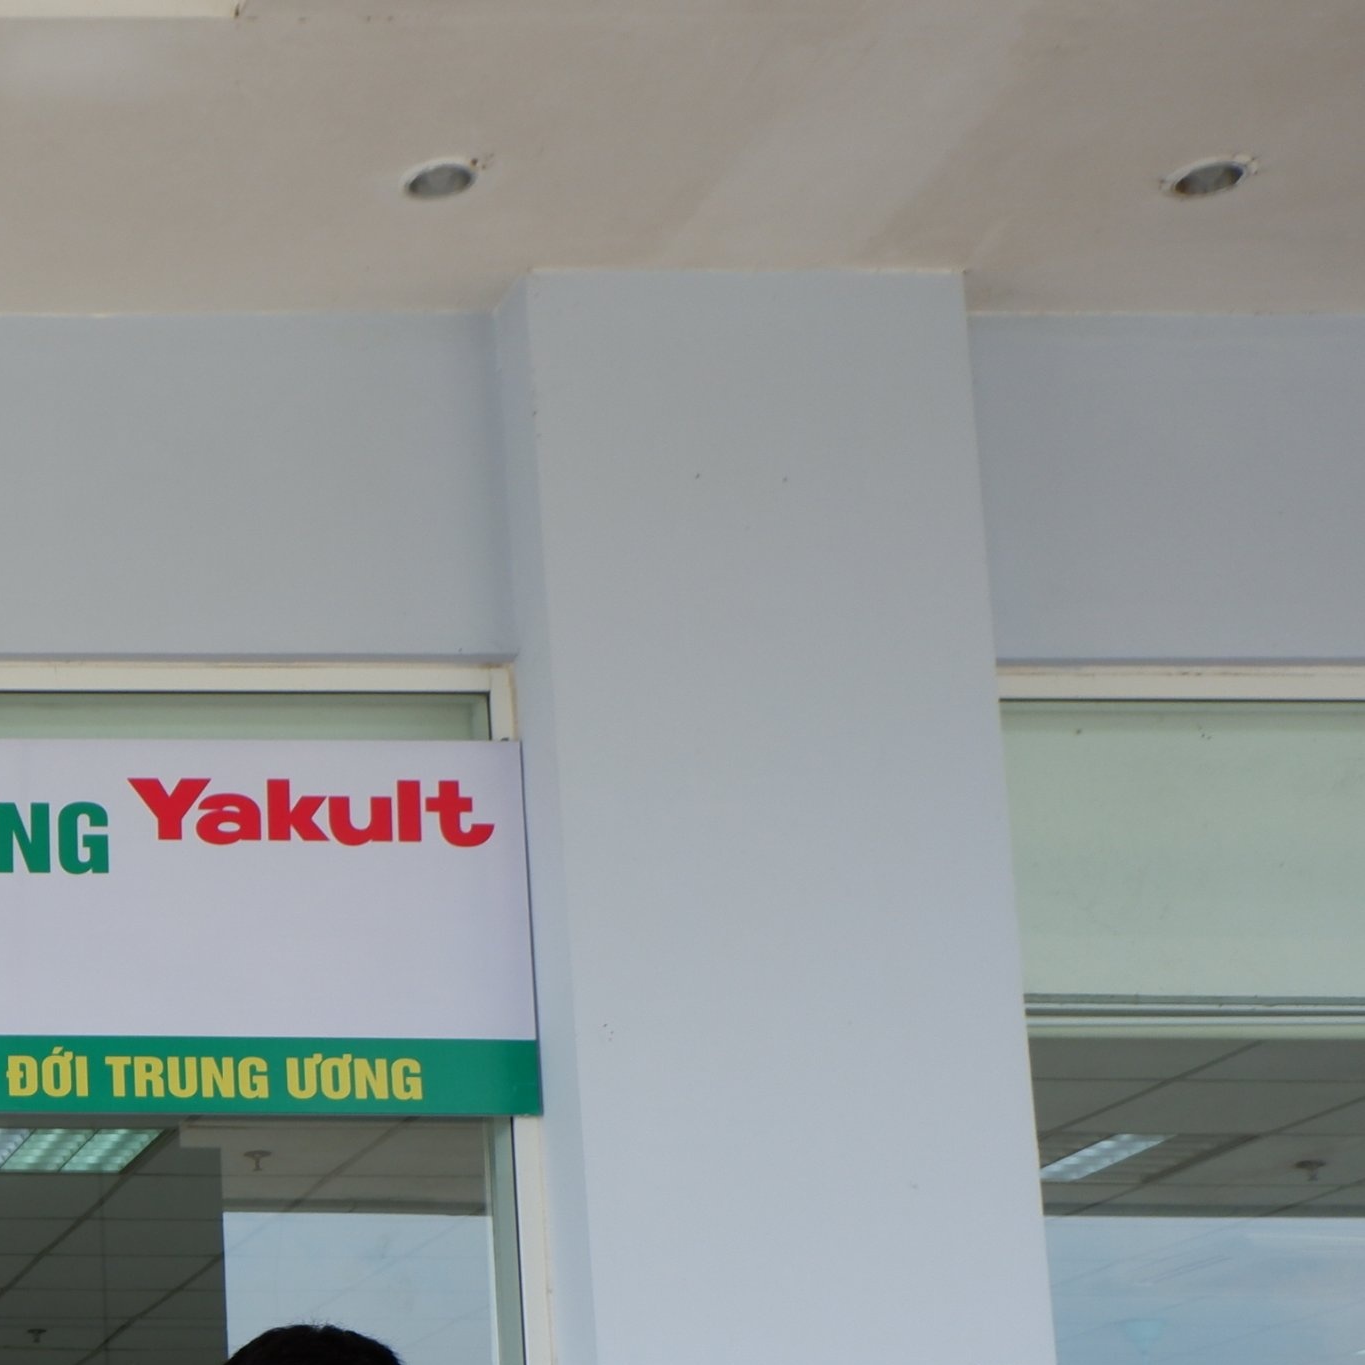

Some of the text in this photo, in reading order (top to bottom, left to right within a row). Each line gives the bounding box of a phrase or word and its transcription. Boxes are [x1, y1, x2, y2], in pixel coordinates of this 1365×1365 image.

[127, 776, 496, 849] Yakult
[7, 1047, 89, 1097] ĐỚI
[105, 1055, 269, 1098] TRUNG
[287, 1053, 423, 1100] ƯƠNG
